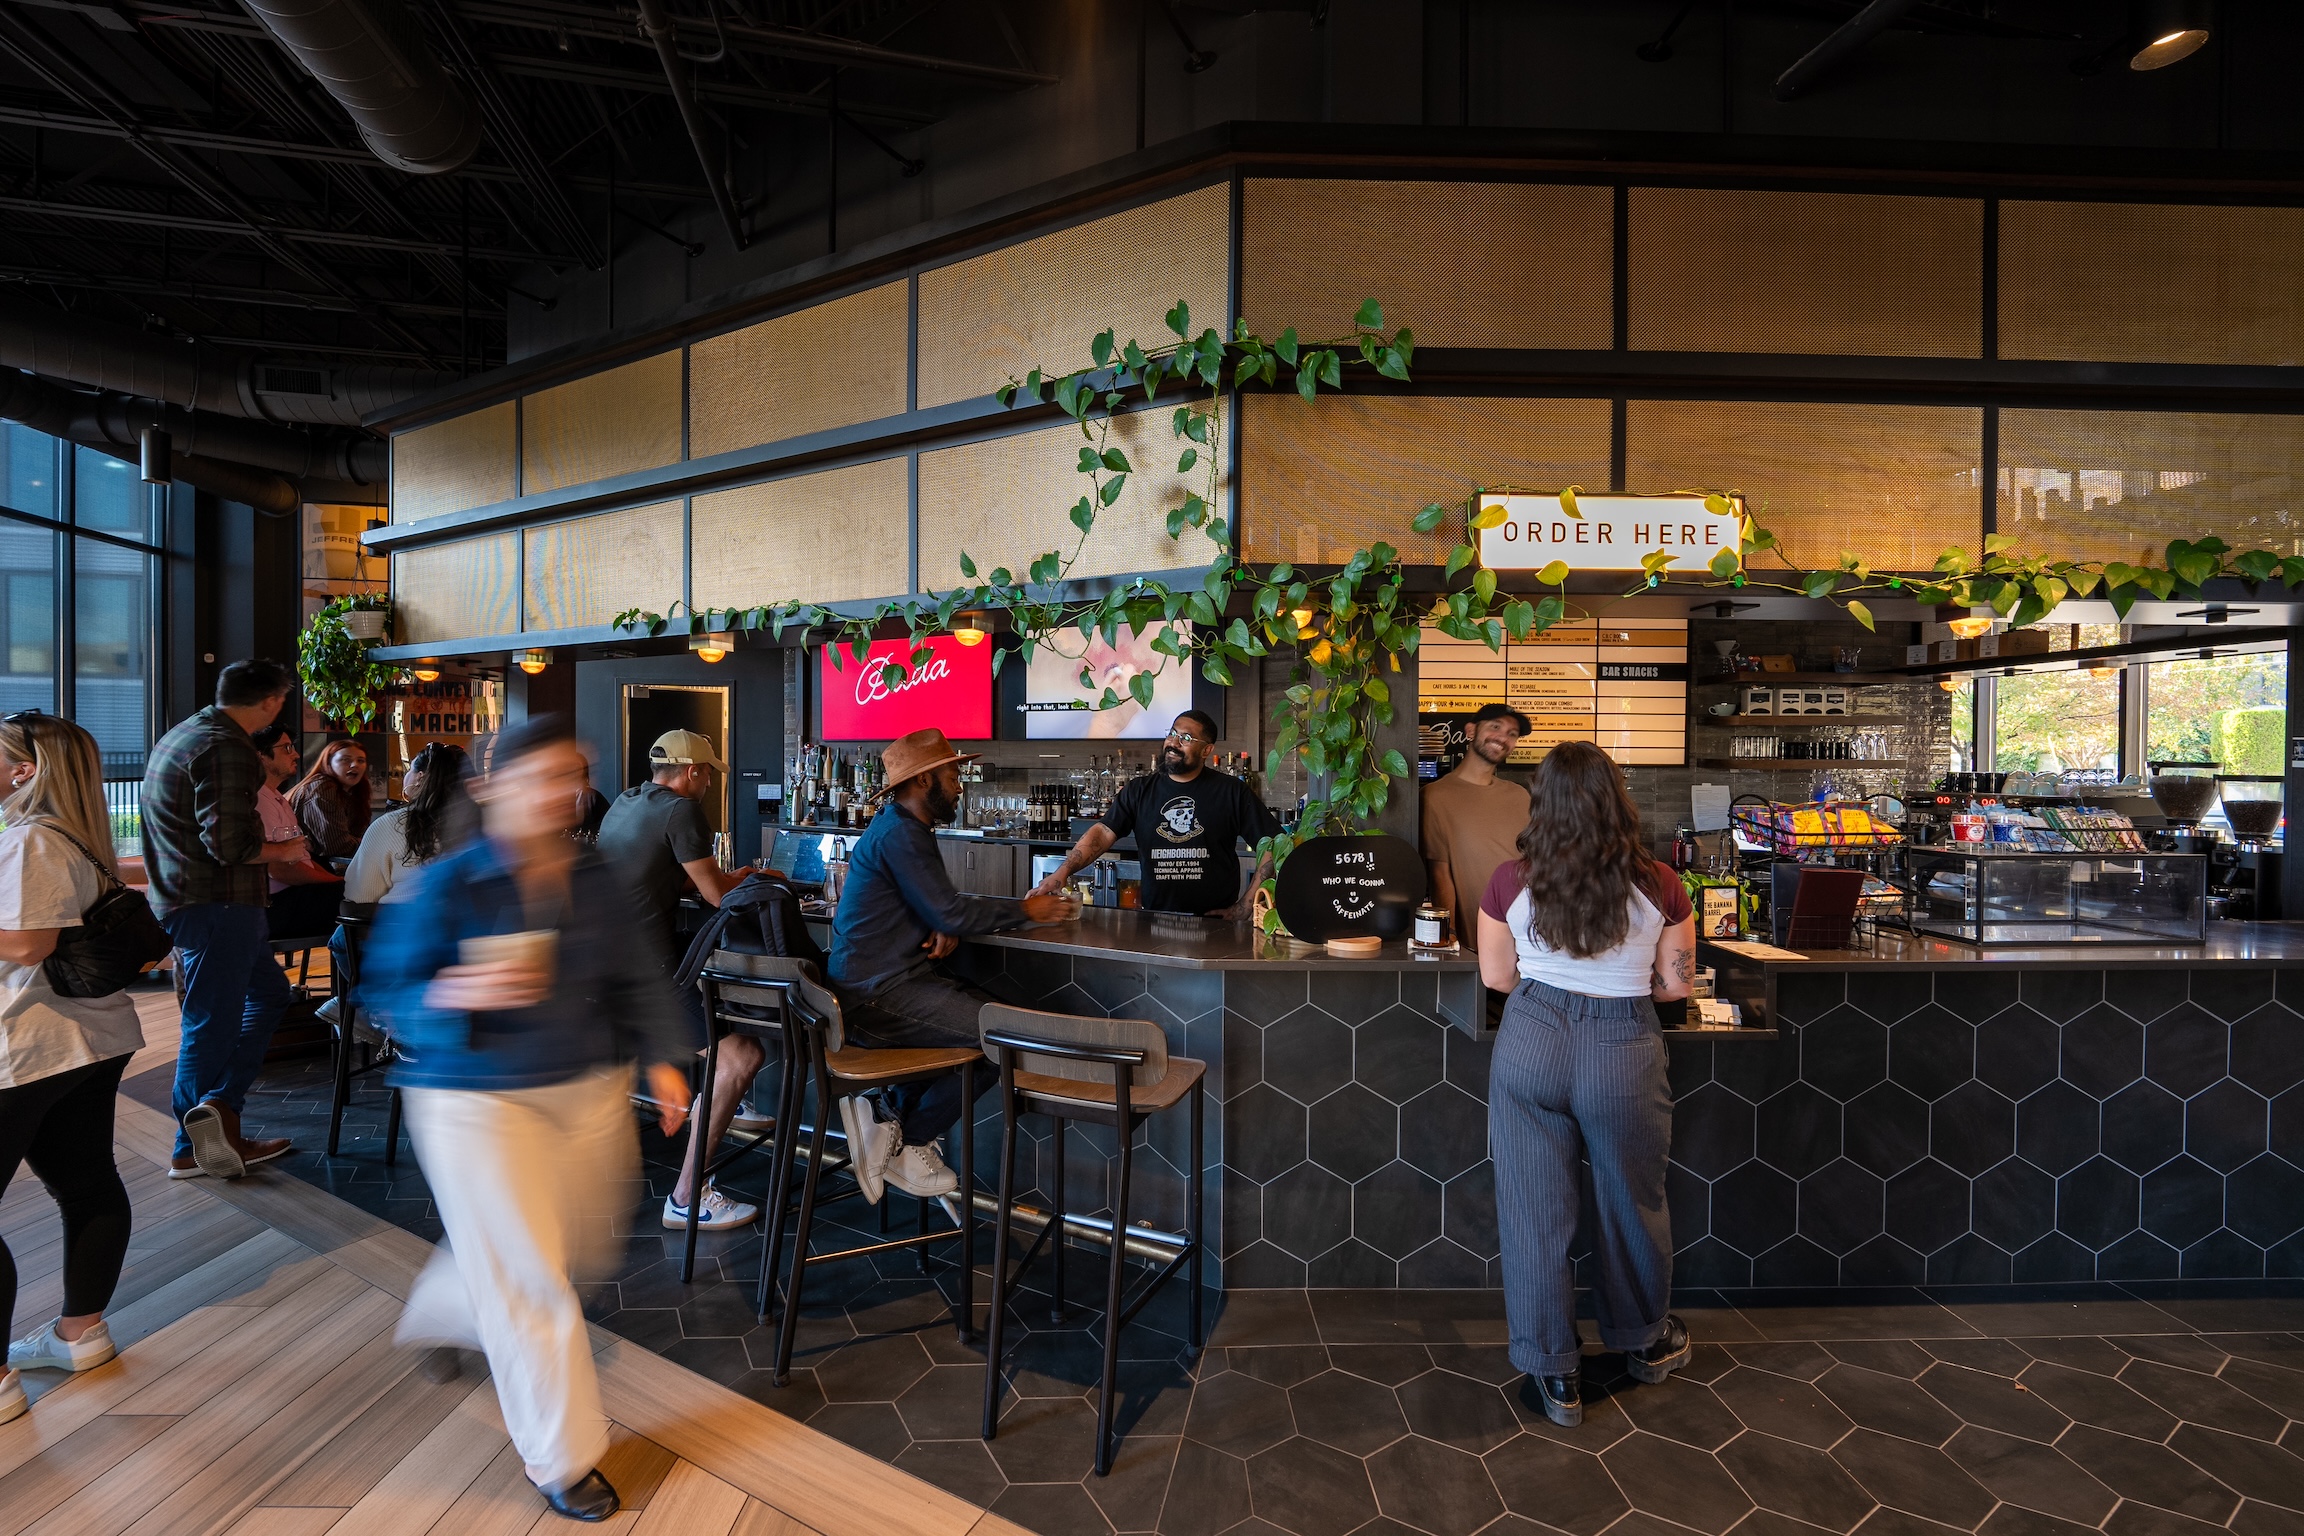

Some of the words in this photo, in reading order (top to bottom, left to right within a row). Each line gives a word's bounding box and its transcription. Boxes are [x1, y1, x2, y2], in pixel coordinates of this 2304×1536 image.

[1503, 521, 1613, 544] ORDER
[1634, 523, 1719, 545] HERE
[1602, 666, 1621, 677] BAR
[1622, 666, 1659, 678] SNACKS
[413, 680, 497, 698] CONVEYING
[1016, 704, 1030, 712] right
[1031, 703, 1042, 711] into
[1043, 703, 1056, 711] that,
[1322, 876, 1342, 886] WHO
[1344, 877, 1357, 885] WE
[1358, 879, 1385, 887] GONNA
[1332, 898, 1375, 919] CAFFEINATE
[1713, 901, 1733, 909] BANANA
[1704, 909, 1722, 917] BARREL
